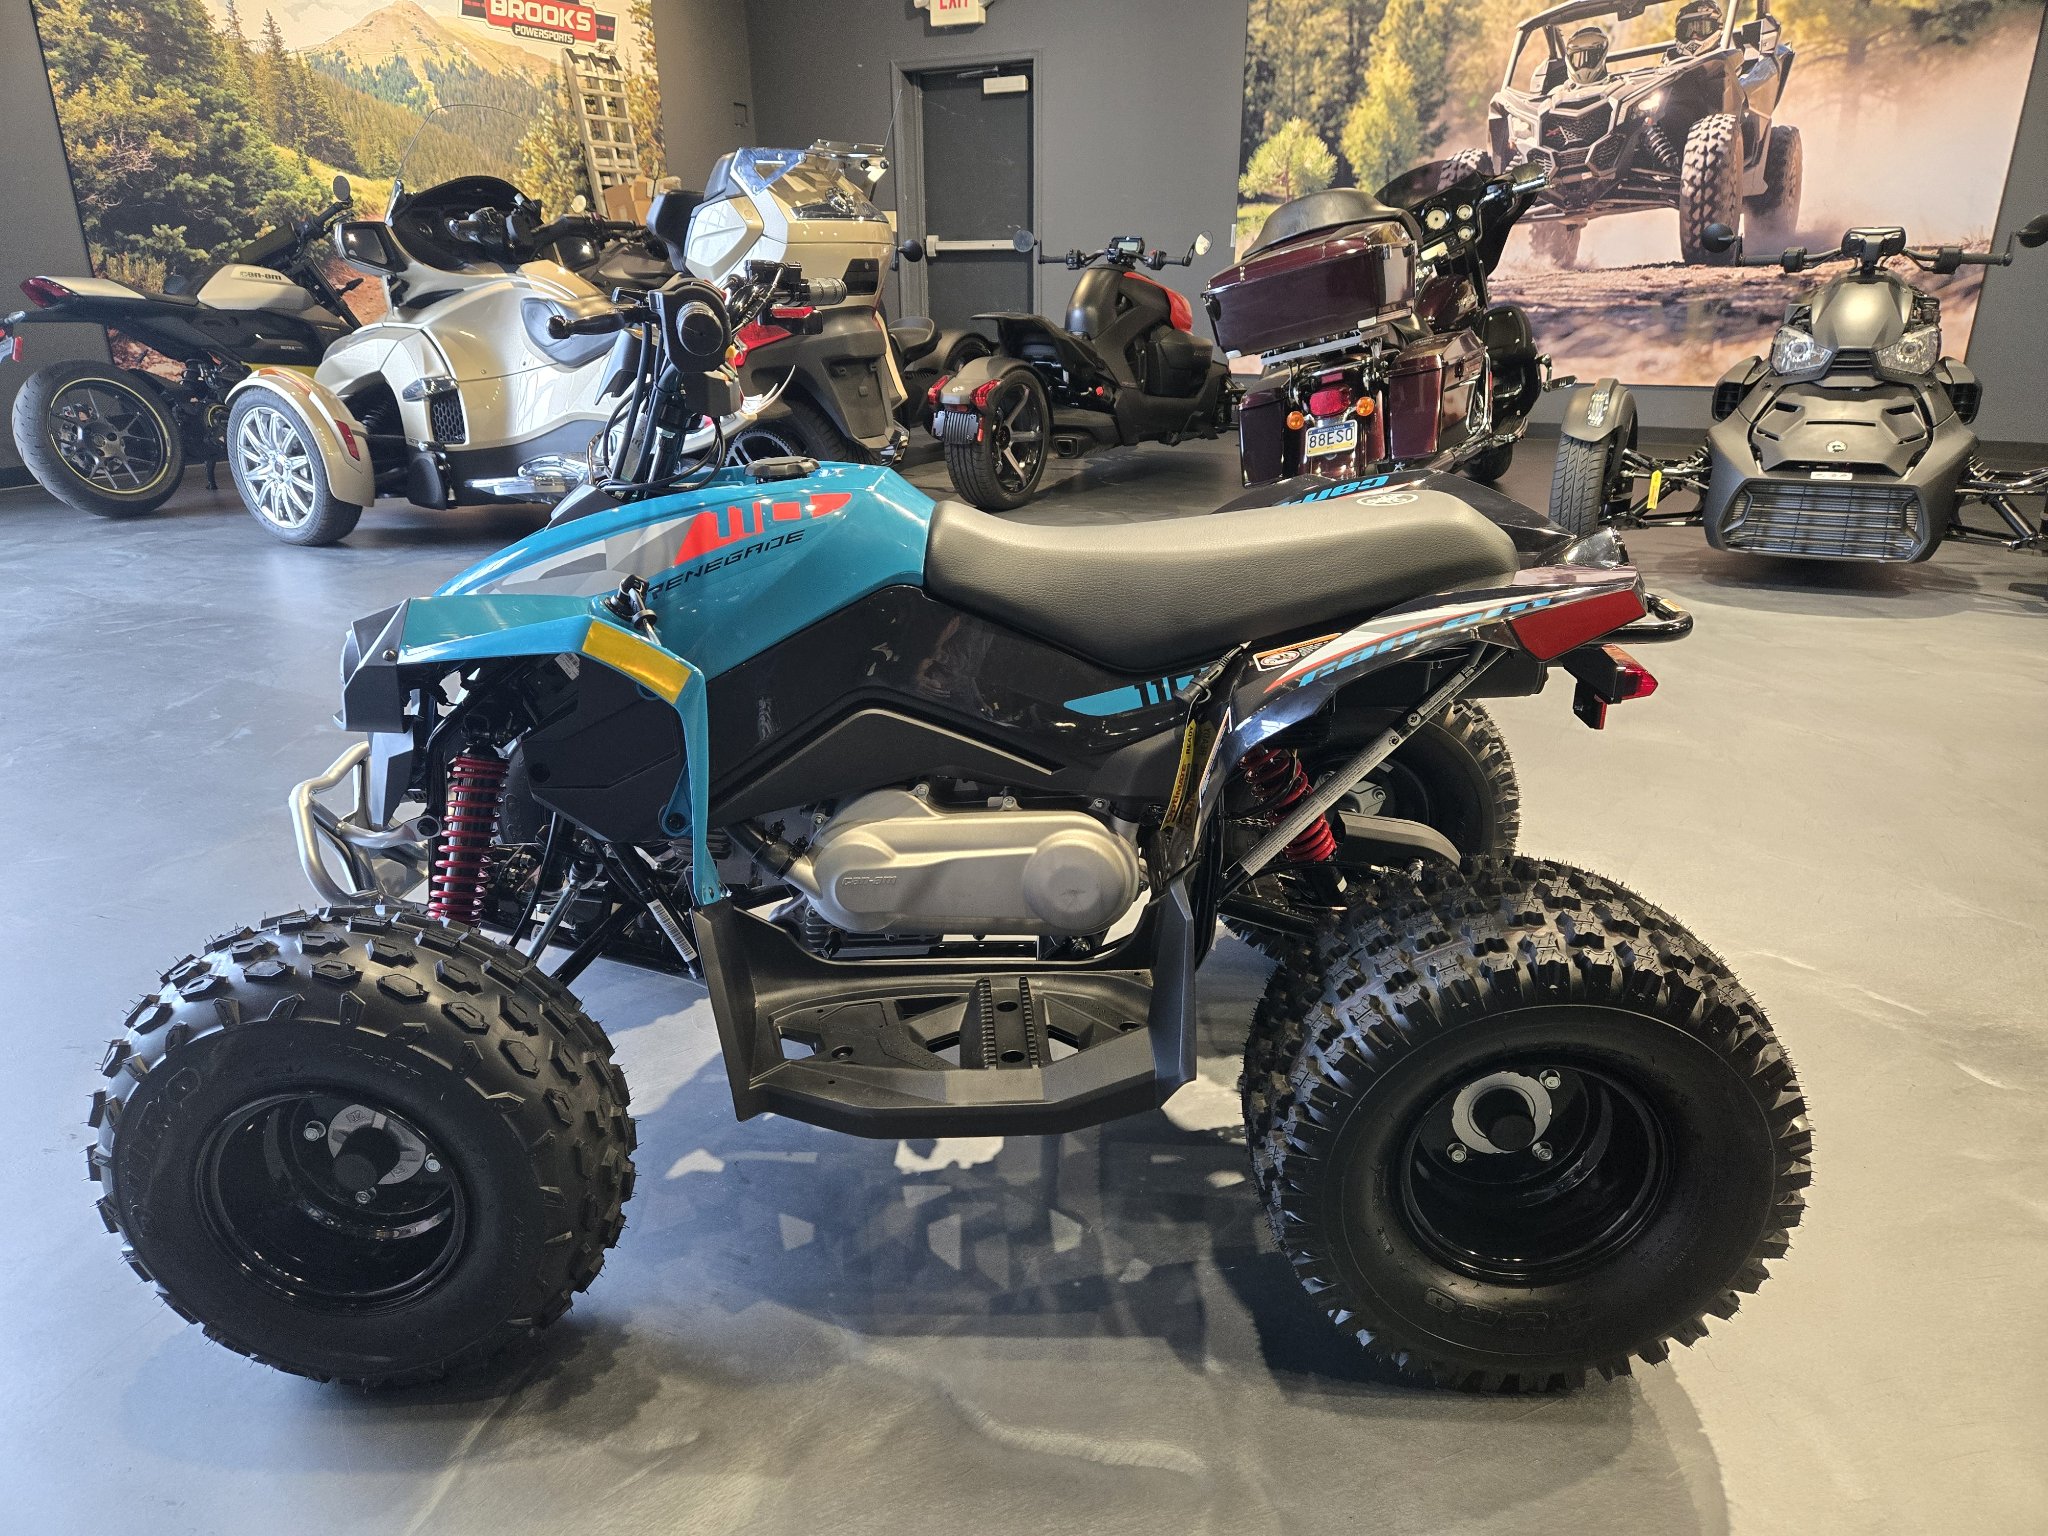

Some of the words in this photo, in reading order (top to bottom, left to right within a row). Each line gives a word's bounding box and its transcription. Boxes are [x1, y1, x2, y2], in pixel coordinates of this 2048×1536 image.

[490, 0, 592, 32] BROOKS
[514, 24, 574, 44] POWERSPORTS
[240, 271, 282, 281] can-am
[1185, 726, 1194, 755] READY
[841, 875, 897, 887] can-am
